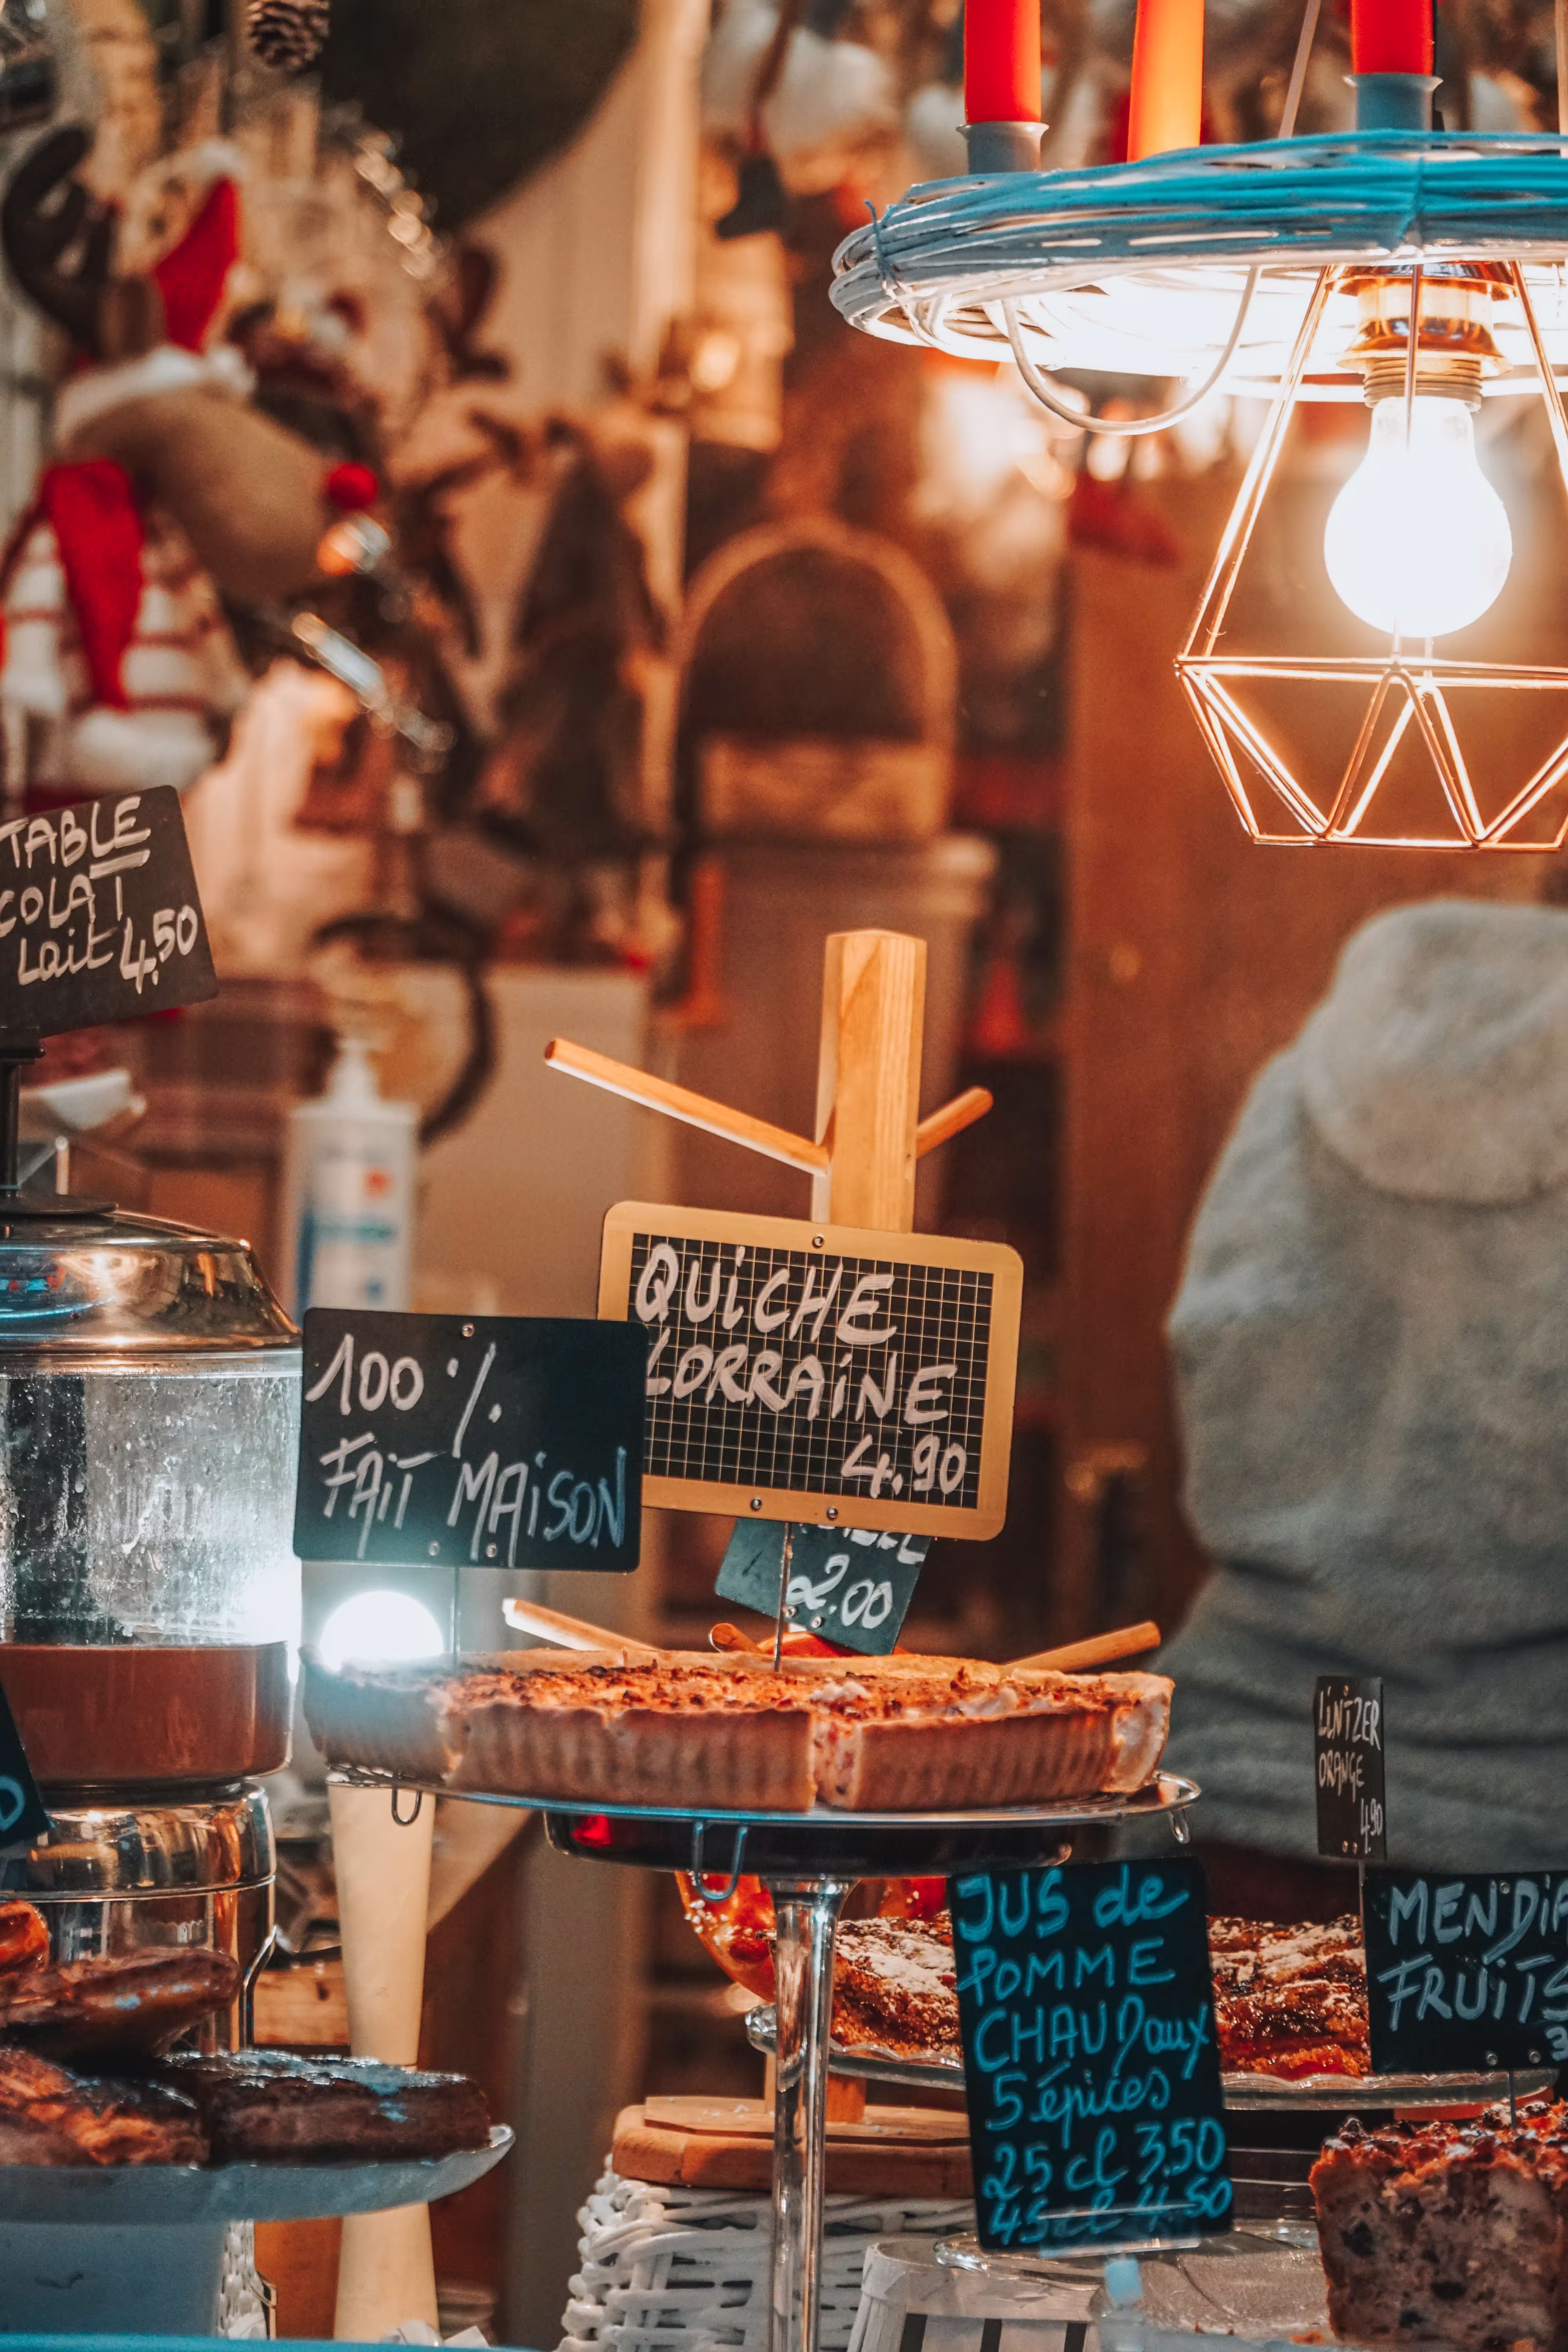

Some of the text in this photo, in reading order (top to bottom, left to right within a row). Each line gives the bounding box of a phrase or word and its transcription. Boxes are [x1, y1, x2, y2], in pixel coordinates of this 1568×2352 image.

[305, 1334, 425, 1415] 100
[785, 1553, 893, 1629] 2.00
[956, 1863, 1190, 1942] JUS de
[956, 1936, 1176, 2006] POMME
[985, 2061, 1171, 2150] 5 épices
[982, 2142, 1054, 2200] 25
[1063, 2126, 1130, 2191] cl
[989, 2196, 1049, 2245] 45
